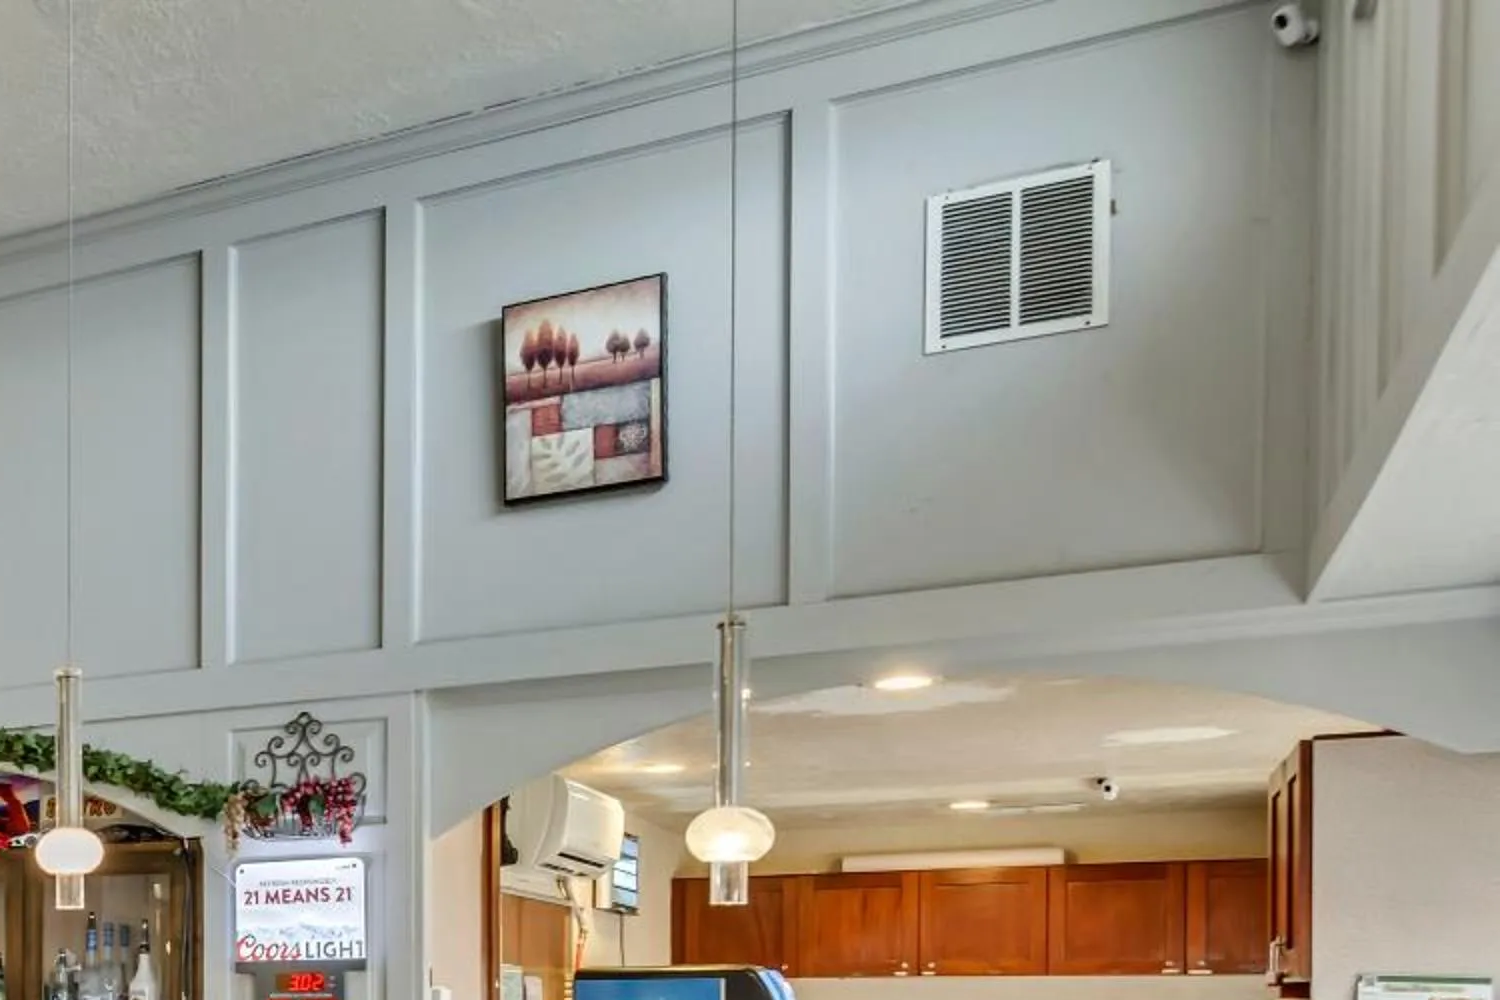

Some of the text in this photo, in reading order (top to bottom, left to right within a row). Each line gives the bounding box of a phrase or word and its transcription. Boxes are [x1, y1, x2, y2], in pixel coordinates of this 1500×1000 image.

[244, 886, 352, 905] 21 MEANS 21
[236, 933, 364, 961] Coors LIGHT
